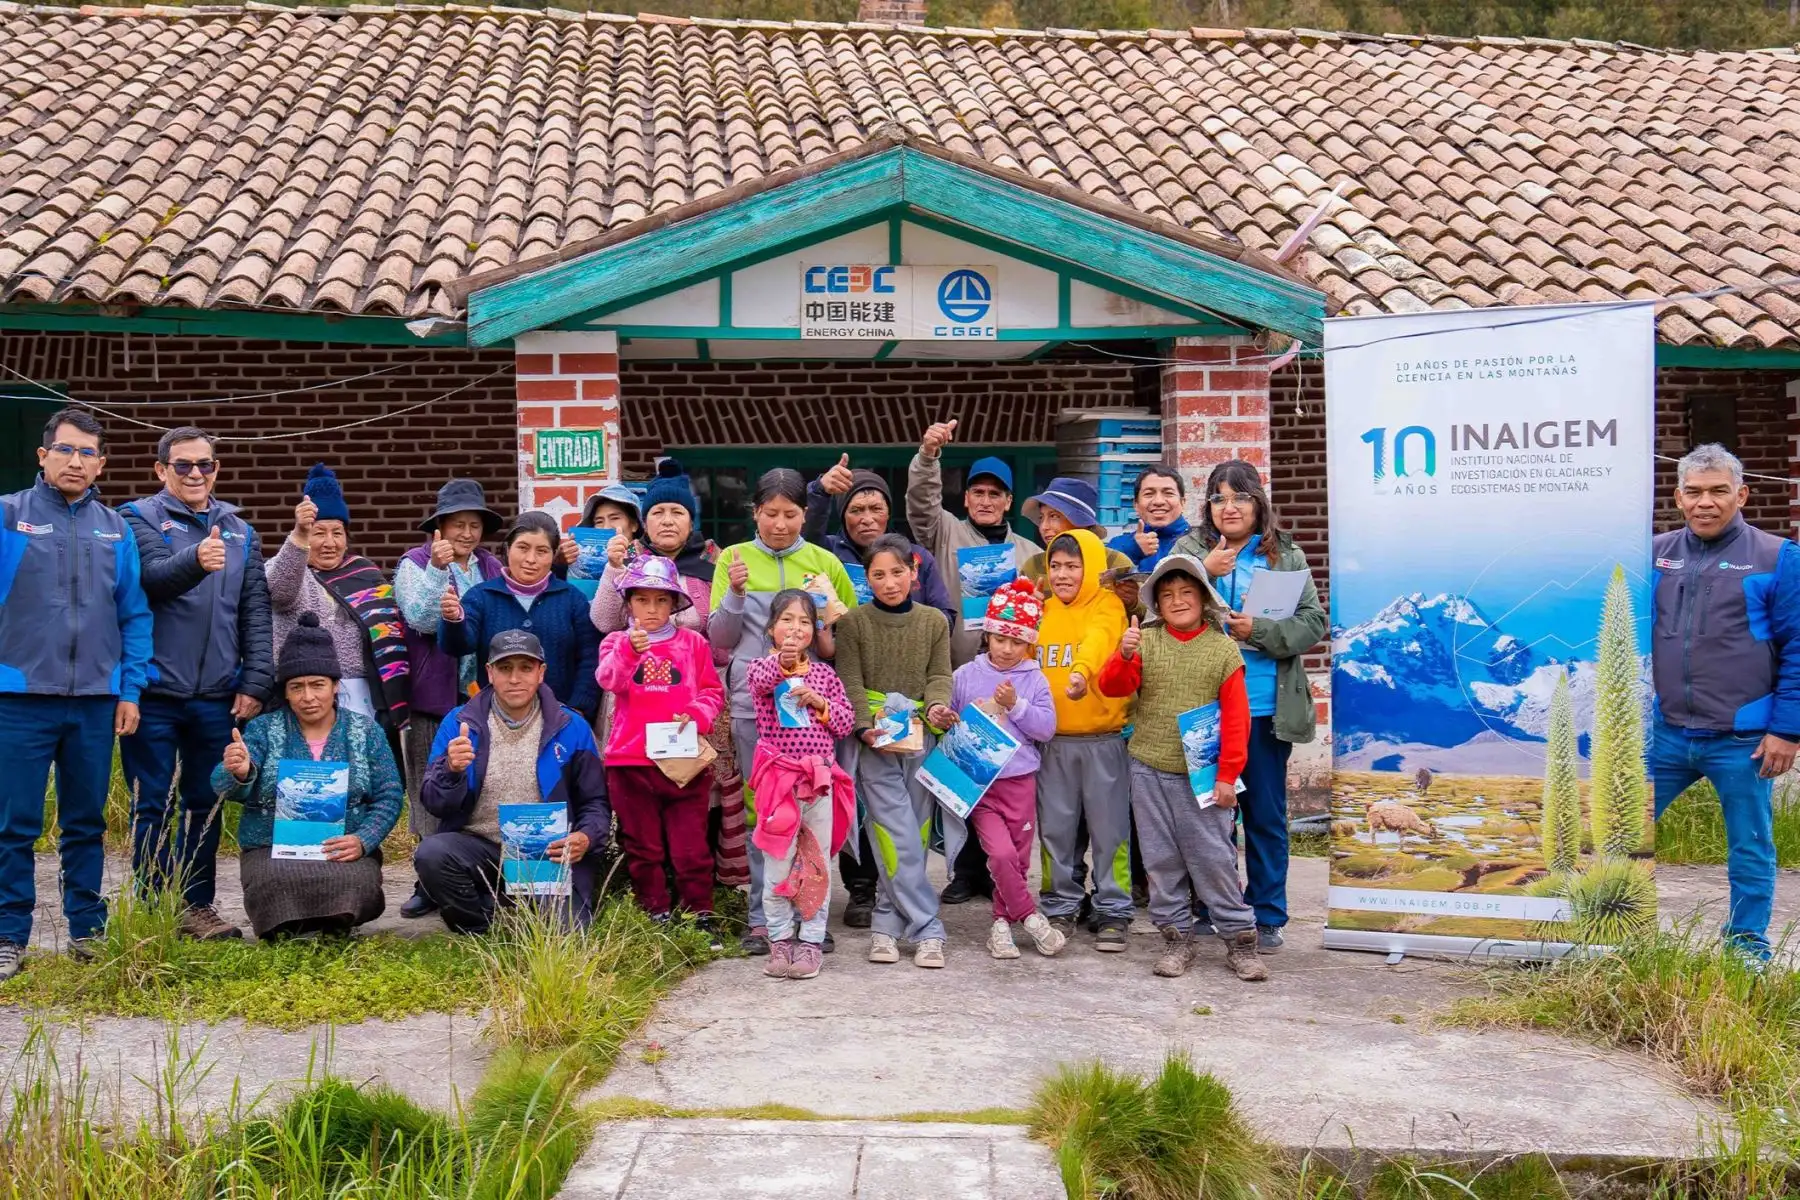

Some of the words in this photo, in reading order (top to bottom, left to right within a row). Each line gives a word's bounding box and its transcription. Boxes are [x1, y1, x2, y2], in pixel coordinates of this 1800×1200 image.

[806, 301, 896, 322] 中国能建
[806, 328, 854, 337] ENERGY
[857, 328, 895, 337] CHINA
[934, 326, 994, 336] CGGC
[1396, 362, 1409, 371] 10
[1415, 360, 1448, 370] AÑOS
[1454, 360, 1468, 368] DE
[1475, 355, 1523, 367] PASIÓN
[1529, 355, 1554, 365] POR
[1560, 354, 1575, 363] LA
[1396, 372, 1451, 382] CIENCIA
[1457, 371, 1473, 380] EN
[1479, 370, 1503, 379] LAS
[1508, 365, 1577, 378] MONTAÑAS
[1451, 418, 1617, 451] INAIGEM
[539, 435, 601, 468] ENTRADA
[1360, 425, 1436, 484] 10
[1451, 455, 1504, 466] INSTITUTO
[1506, 454, 1556, 465] NACIONAL
[1559, 453, 1573, 463] DE
[1451, 468, 1527, 480] INVESTIGACIÓN
[1530, 468, 1543, 478] EN
[1545, 466, 1603, 478] GLACIARES
[1605, 467, 1612, 476] Y
[1394, 483, 1437, 495] AÑOS
[1451, 483, 1521, 494] ECOSISTEMAS
[1524, 483, 1537, 493] DE
[1539, 480, 1590, 493] MONTAÑA
[1359, 896, 1501, 912] WWW.INAIGEM.GOB.PE
